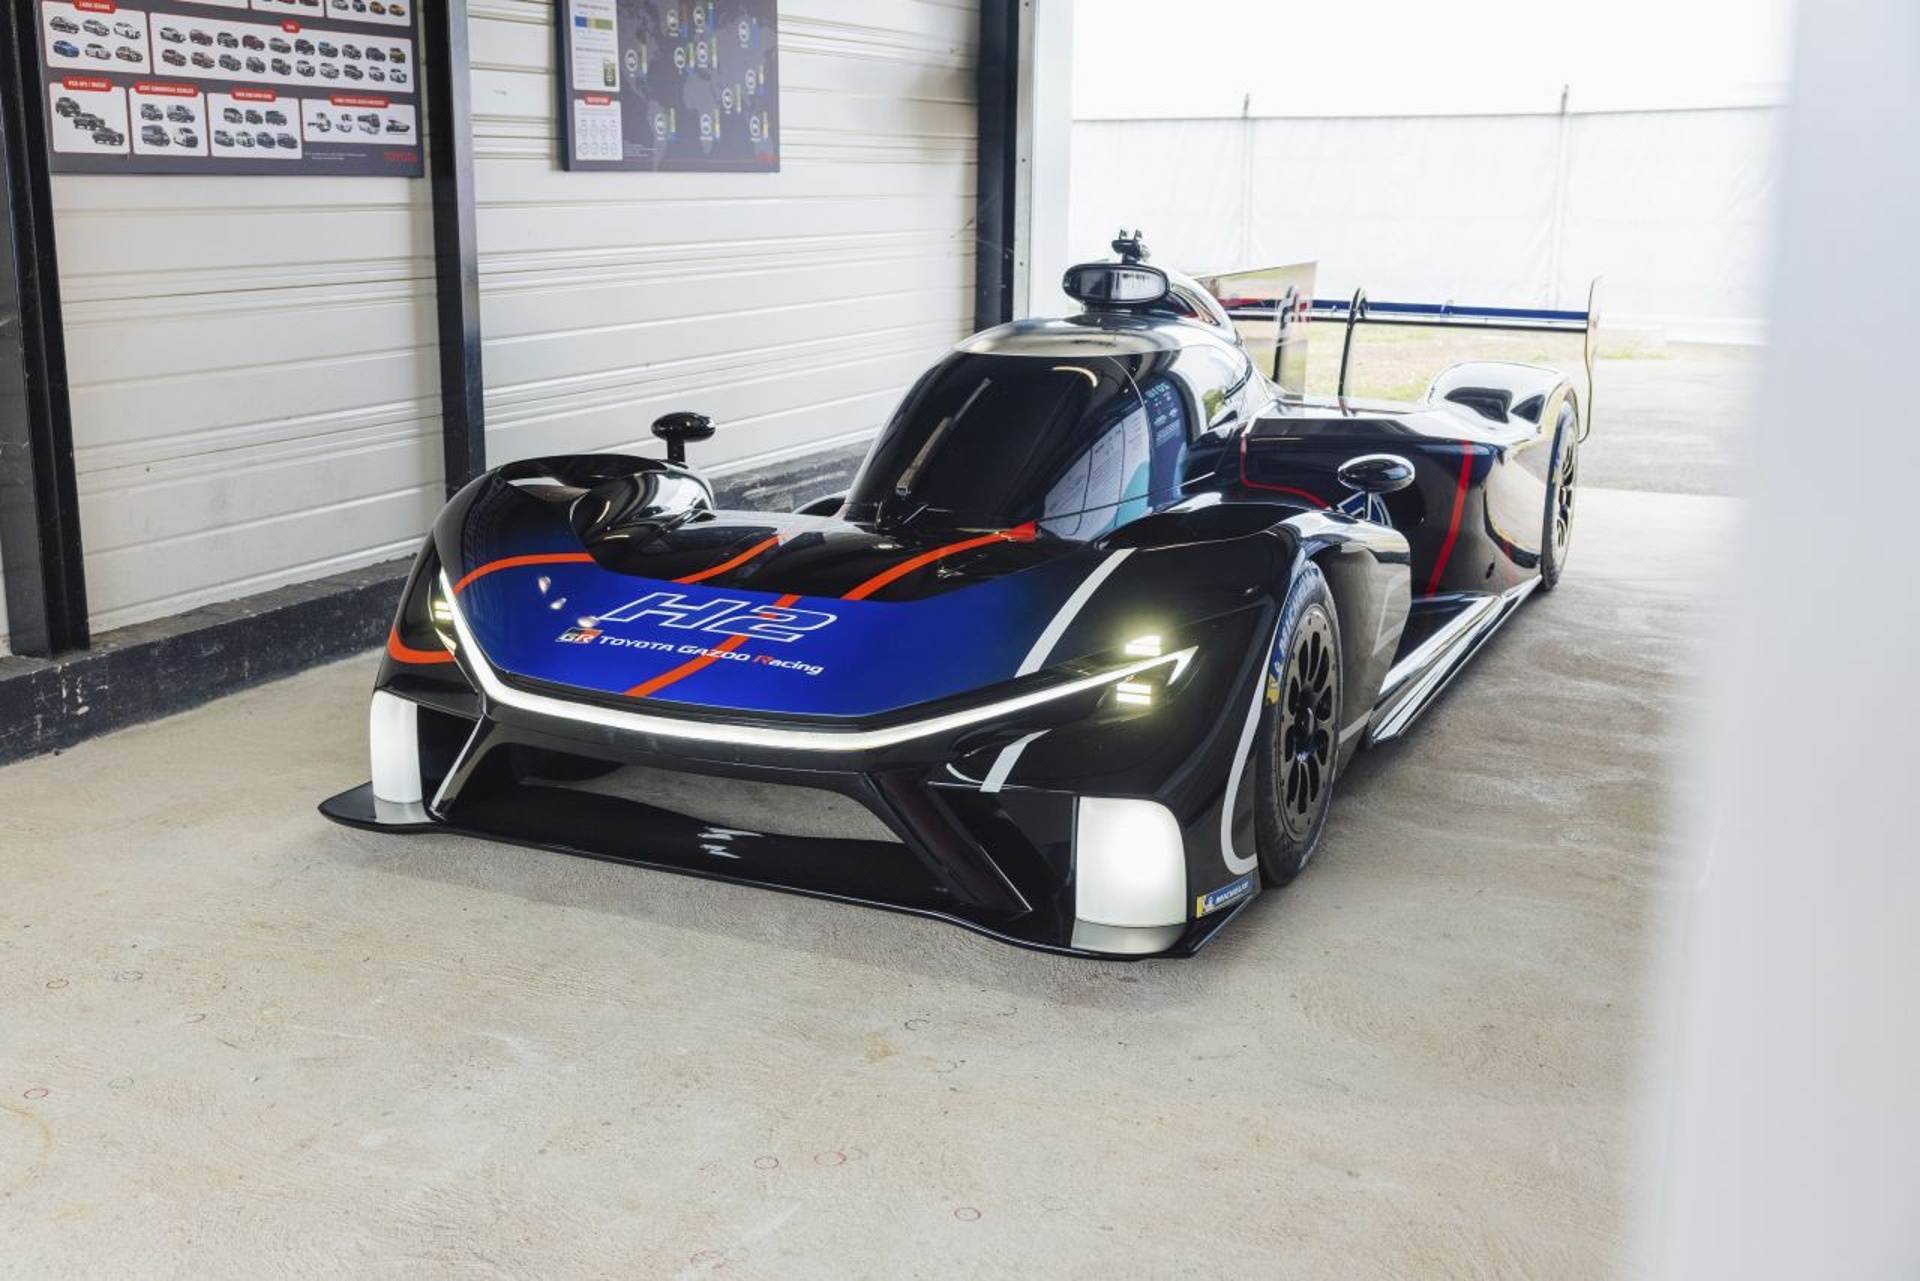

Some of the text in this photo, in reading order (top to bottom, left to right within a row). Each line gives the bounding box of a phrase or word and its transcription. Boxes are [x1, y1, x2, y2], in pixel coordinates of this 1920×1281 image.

[597, 592, 838, 643] H2
[556, 631, 825, 676] GR TOYOTA GAZOO Racing
